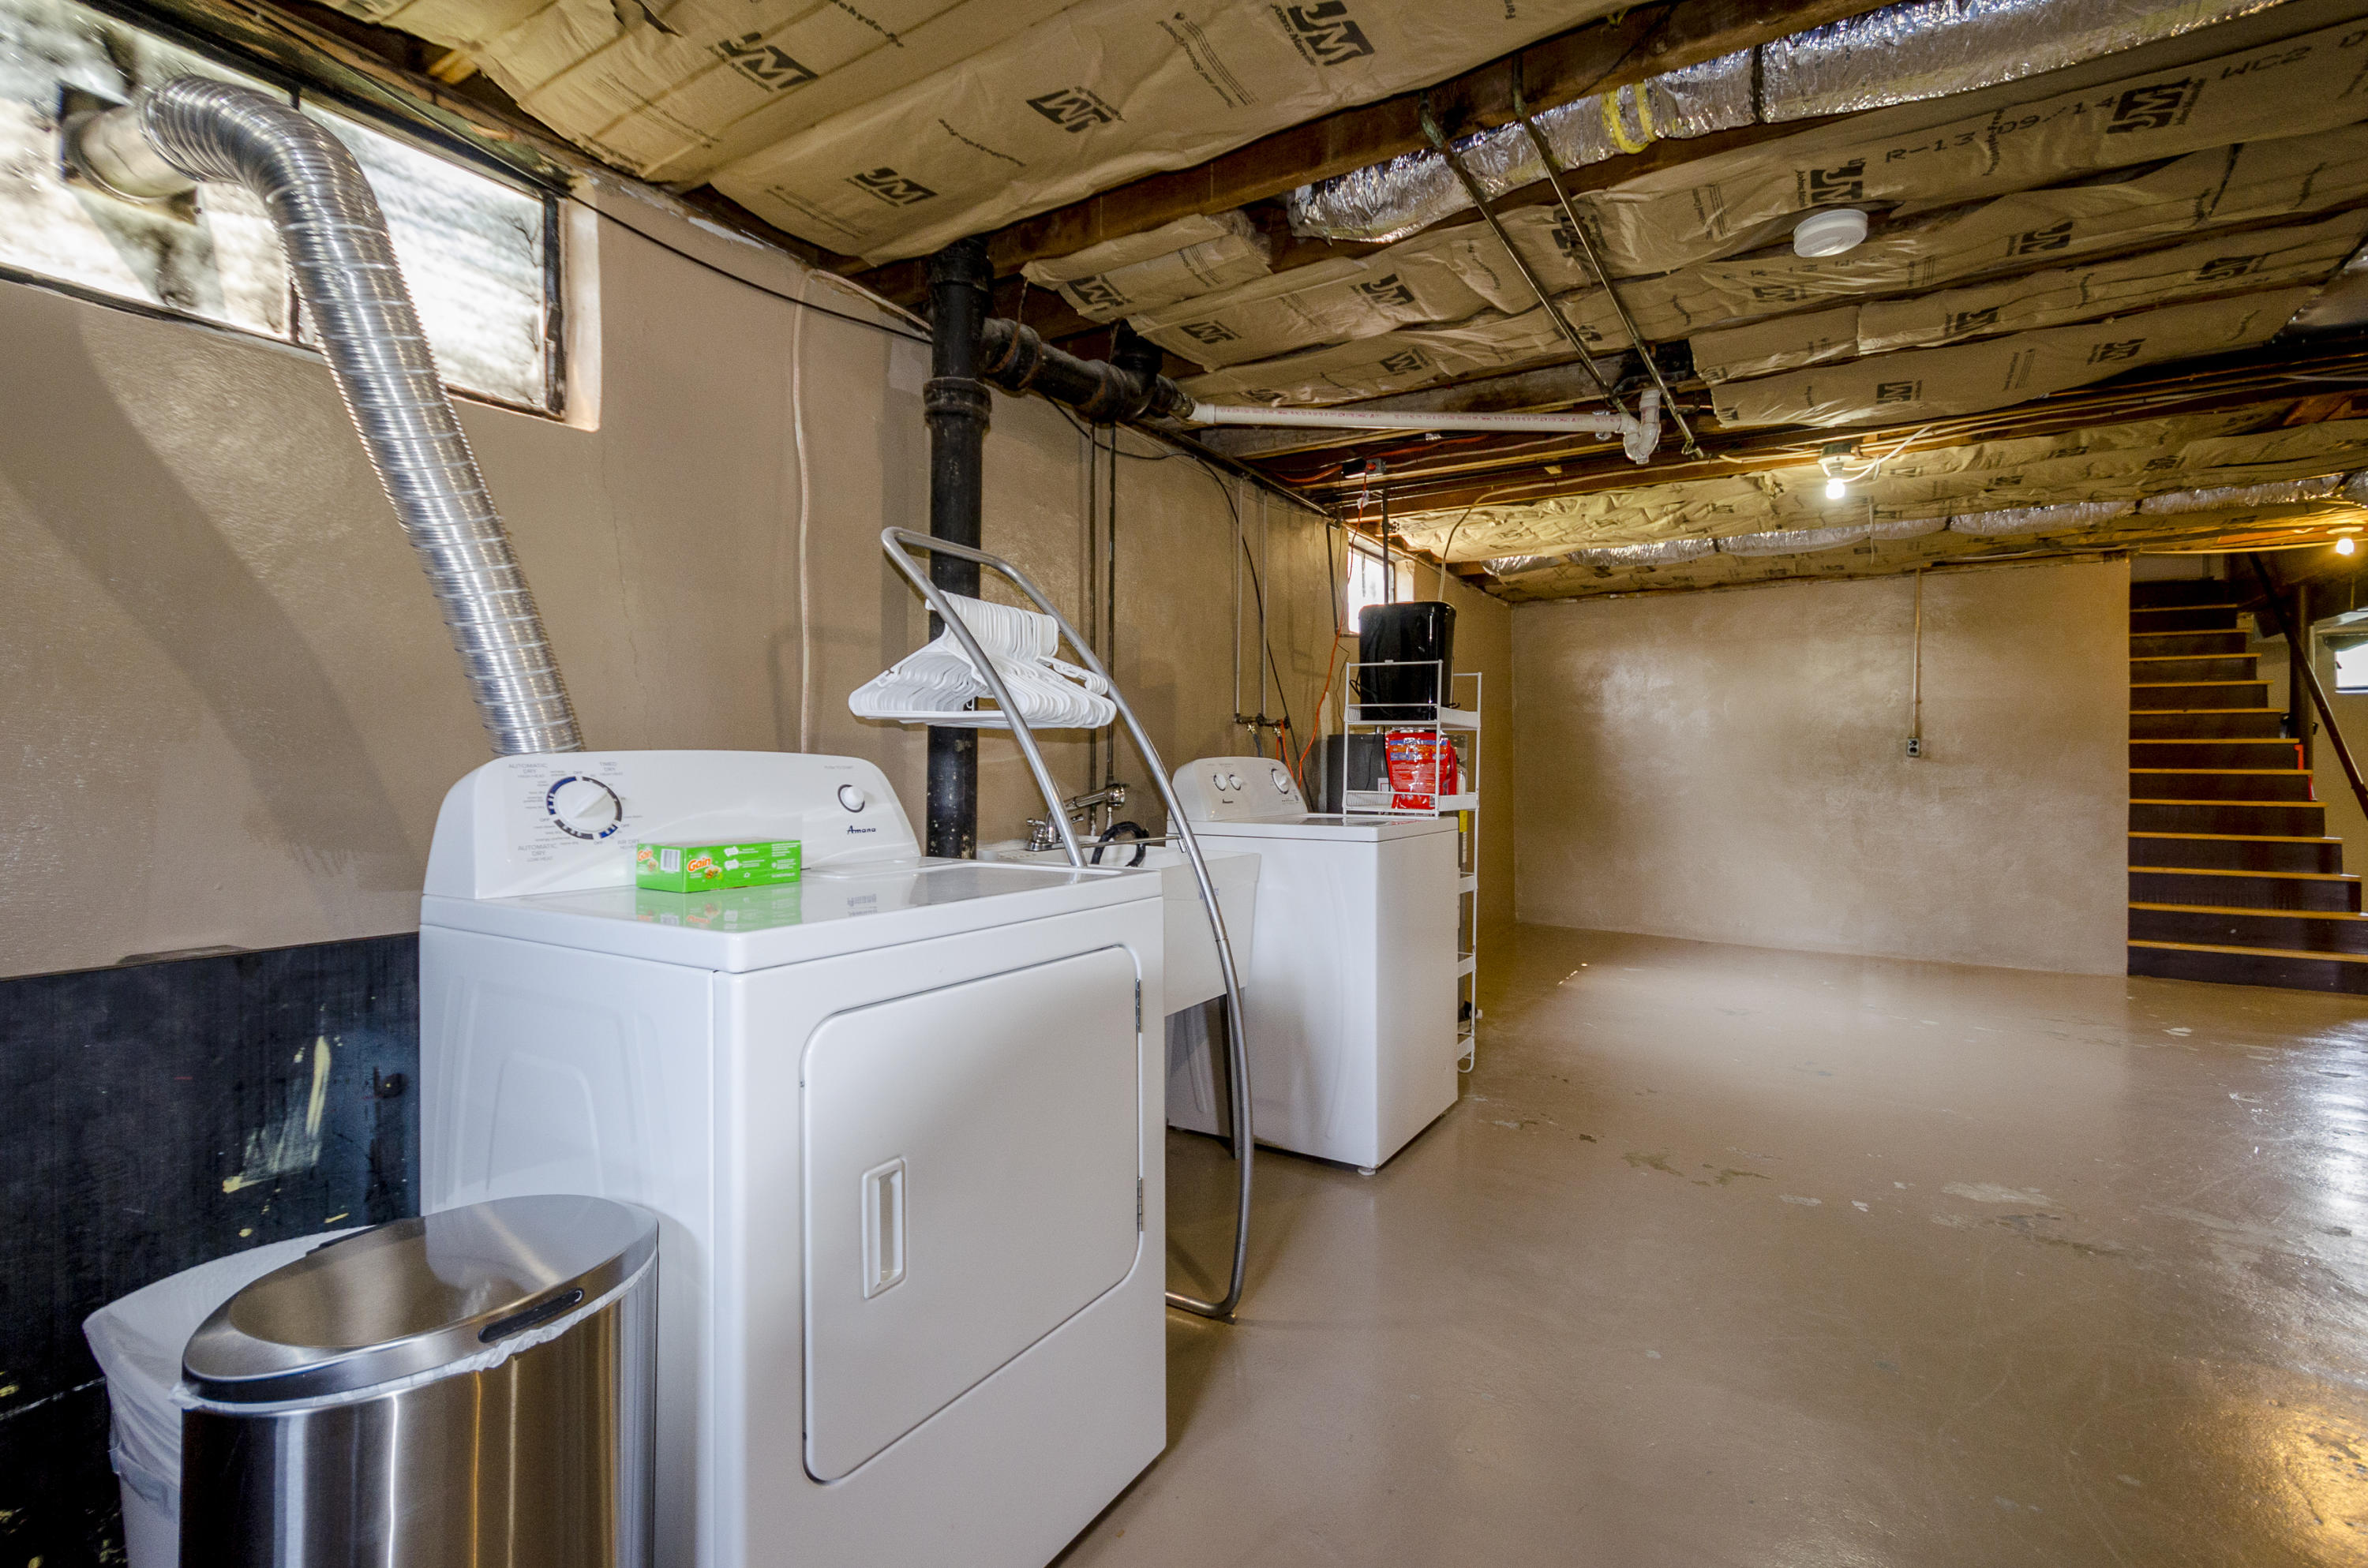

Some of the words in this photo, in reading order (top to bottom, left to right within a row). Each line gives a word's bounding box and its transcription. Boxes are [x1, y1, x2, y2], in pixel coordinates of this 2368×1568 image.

[1287, 0, 1375, 66] JM
[717, 32, 819, 89] JM
[1026, 88, 1112, 133] JM
[2105, 77, 2193, 134] JM
[1885, 130, 1976, 163] R-13
[854, 167, 939, 205] JM
[1360, 274, 1414, 306] JM
[1179, 321, 1235, 344] JM
[846, 825, 876, 835] Amana
[637, 848, 654, 862] Gain
[688, 857, 712, 872] Gain
